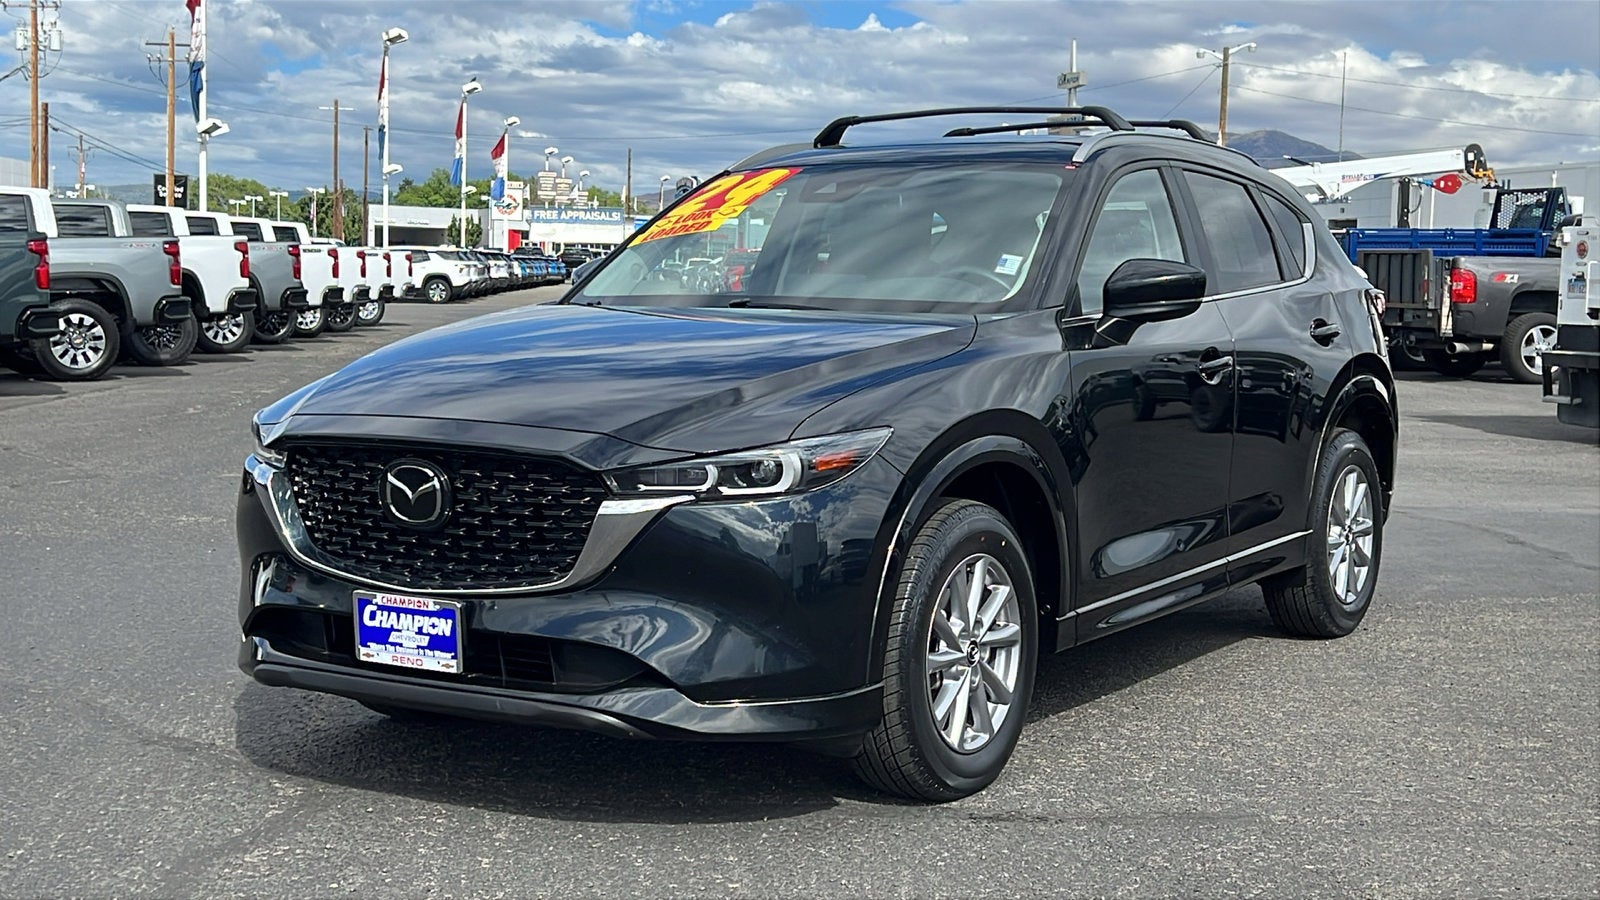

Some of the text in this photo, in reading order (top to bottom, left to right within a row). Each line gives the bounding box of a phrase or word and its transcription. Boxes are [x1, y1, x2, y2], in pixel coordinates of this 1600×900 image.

[533, 210, 621, 221] FREE APPRAISALS!
[670, 210, 716, 227] LOOK
[640, 219, 713, 243] LOADED
[381, 595, 430, 609] CHAMPION
[362, 604, 453, 637] CHAMPION
[391, 633, 427, 645] CHEVROLET
[391, 655, 424, 667] RENO
